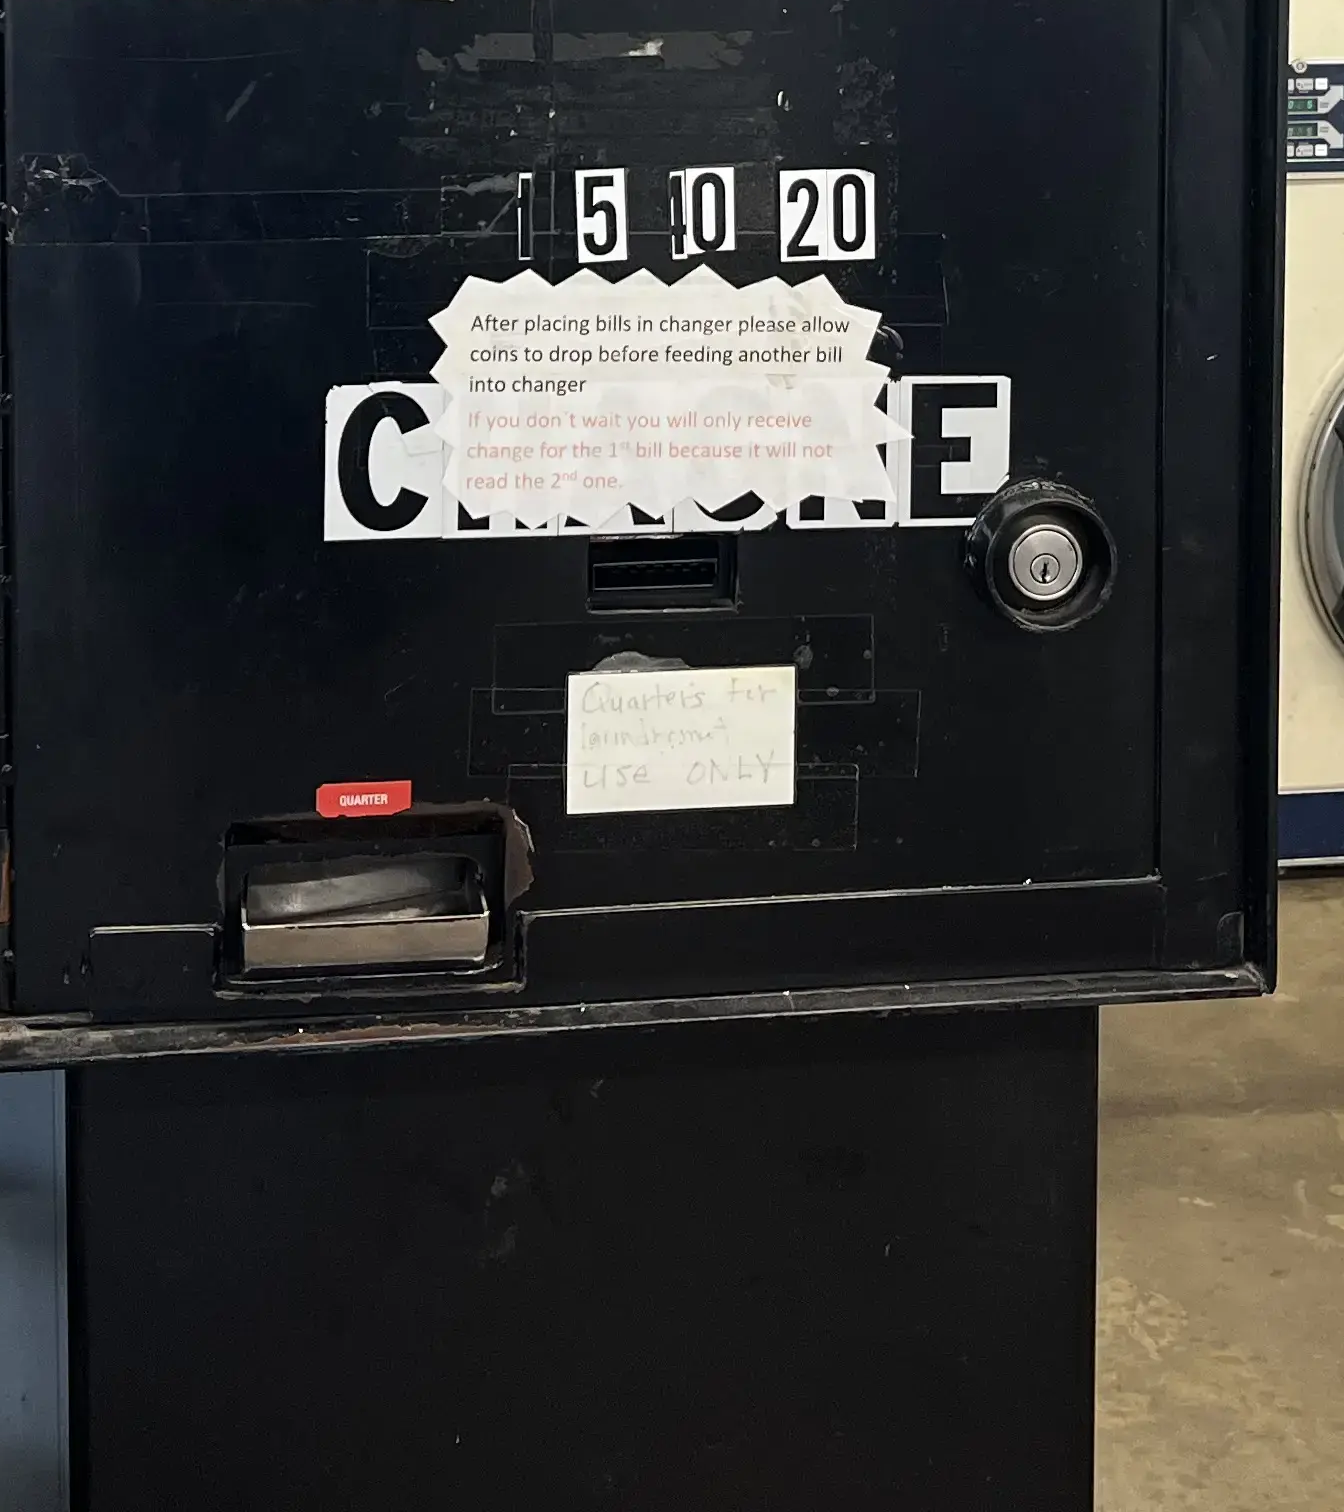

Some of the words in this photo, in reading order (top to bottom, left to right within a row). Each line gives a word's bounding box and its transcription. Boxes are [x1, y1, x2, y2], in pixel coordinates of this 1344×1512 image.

[582, 175, 618, 256] 5
[786, 173, 867, 257] 20
[470, 314, 518, 332] After
[524, 314, 590, 335] placing
[596, 314, 631, 332] bills
[637, 315, 653, 332] in
[659, 315, 732, 336] changer
[738, 315, 796, 336] please
[801, 315, 850, 333] allow
[470, 345, 518, 362] coins
[524, 347, 543, 362] to
[549, 345, 592, 366] drop
[599, 345, 659, 362] before
[665, 345, 733, 366] feeding
[738, 345, 810, 363] another
[816, 346, 842, 363] bill
[469, 376, 506, 392] into
[512, 375, 586, 396] changer
[468, 411, 481, 428] If
[486, 415, 519, 431] you
[582, 412, 621, 428] wait
[627, 415, 660, 431] you
[666, 411, 697, 428] will
[703, 411, 741, 431] only
[747, 412, 812, 428] receive
[467, 442, 534, 462] change
[540, 442, 567, 458] for
[572, 442, 602, 458] the
[636, 442, 662, 458] bill
[669, 442, 742, 458] because
[748, 443, 760, 458] it
[766, 442, 796, 458] will
[802, 444, 833, 458] not
[466, 473, 508, 489] read
[514, 473, 544, 489] the
[550, 471, 577, 489] 2nd
[583, 475, 624, 489] one.
[686, 750, 775, 785] ONLY
[339, 794, 388, 806] QUARTER
